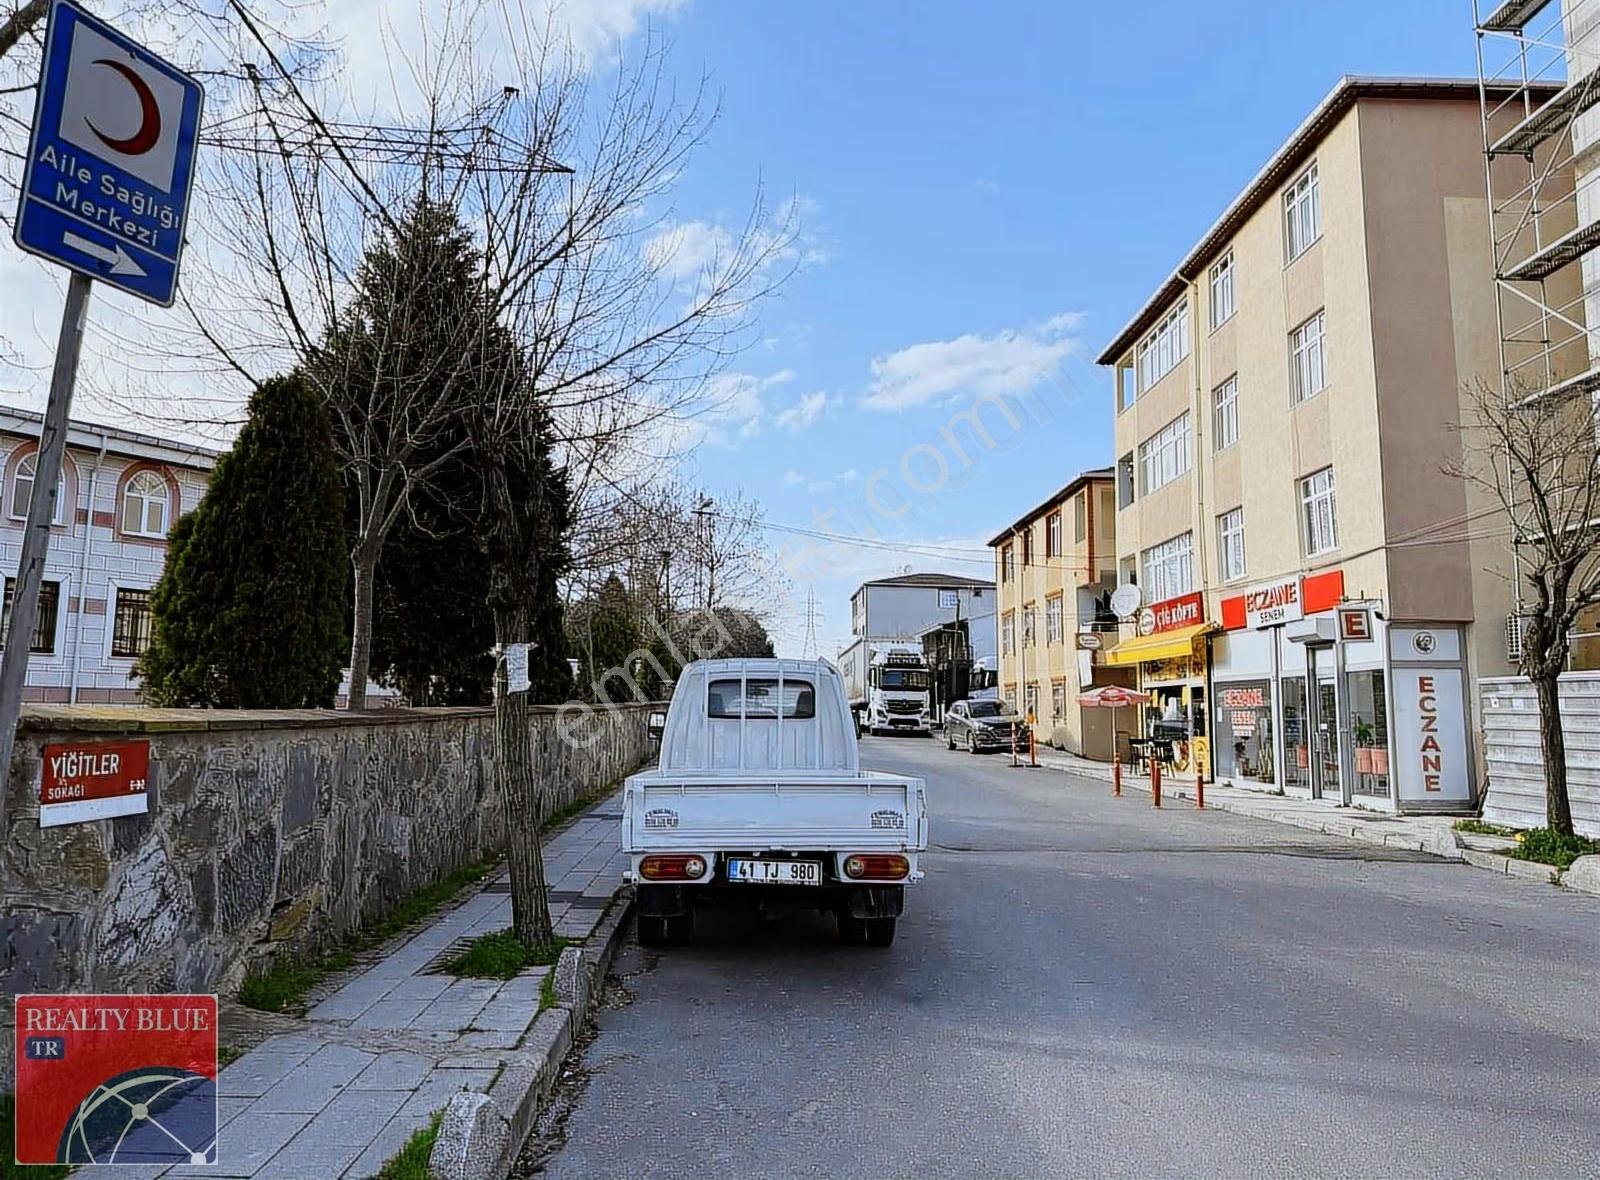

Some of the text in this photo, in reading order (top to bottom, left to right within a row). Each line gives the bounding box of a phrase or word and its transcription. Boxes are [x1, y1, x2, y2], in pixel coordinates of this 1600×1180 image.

[39, 145, 180, 230] Aile Sağlığı
[55, 181, 159, 248] Merkezi
[1245, 582, 1298, 613] ECZANE
[1259, 608, 1285, 624] SENEM
[1344, 613, 1366, 636] E
[1418, 676, 1442, 793] ECZANE
[51, 751, 119, 779] YİĞİTLER
[739, 862, 815, 880] 41 TJ 980
